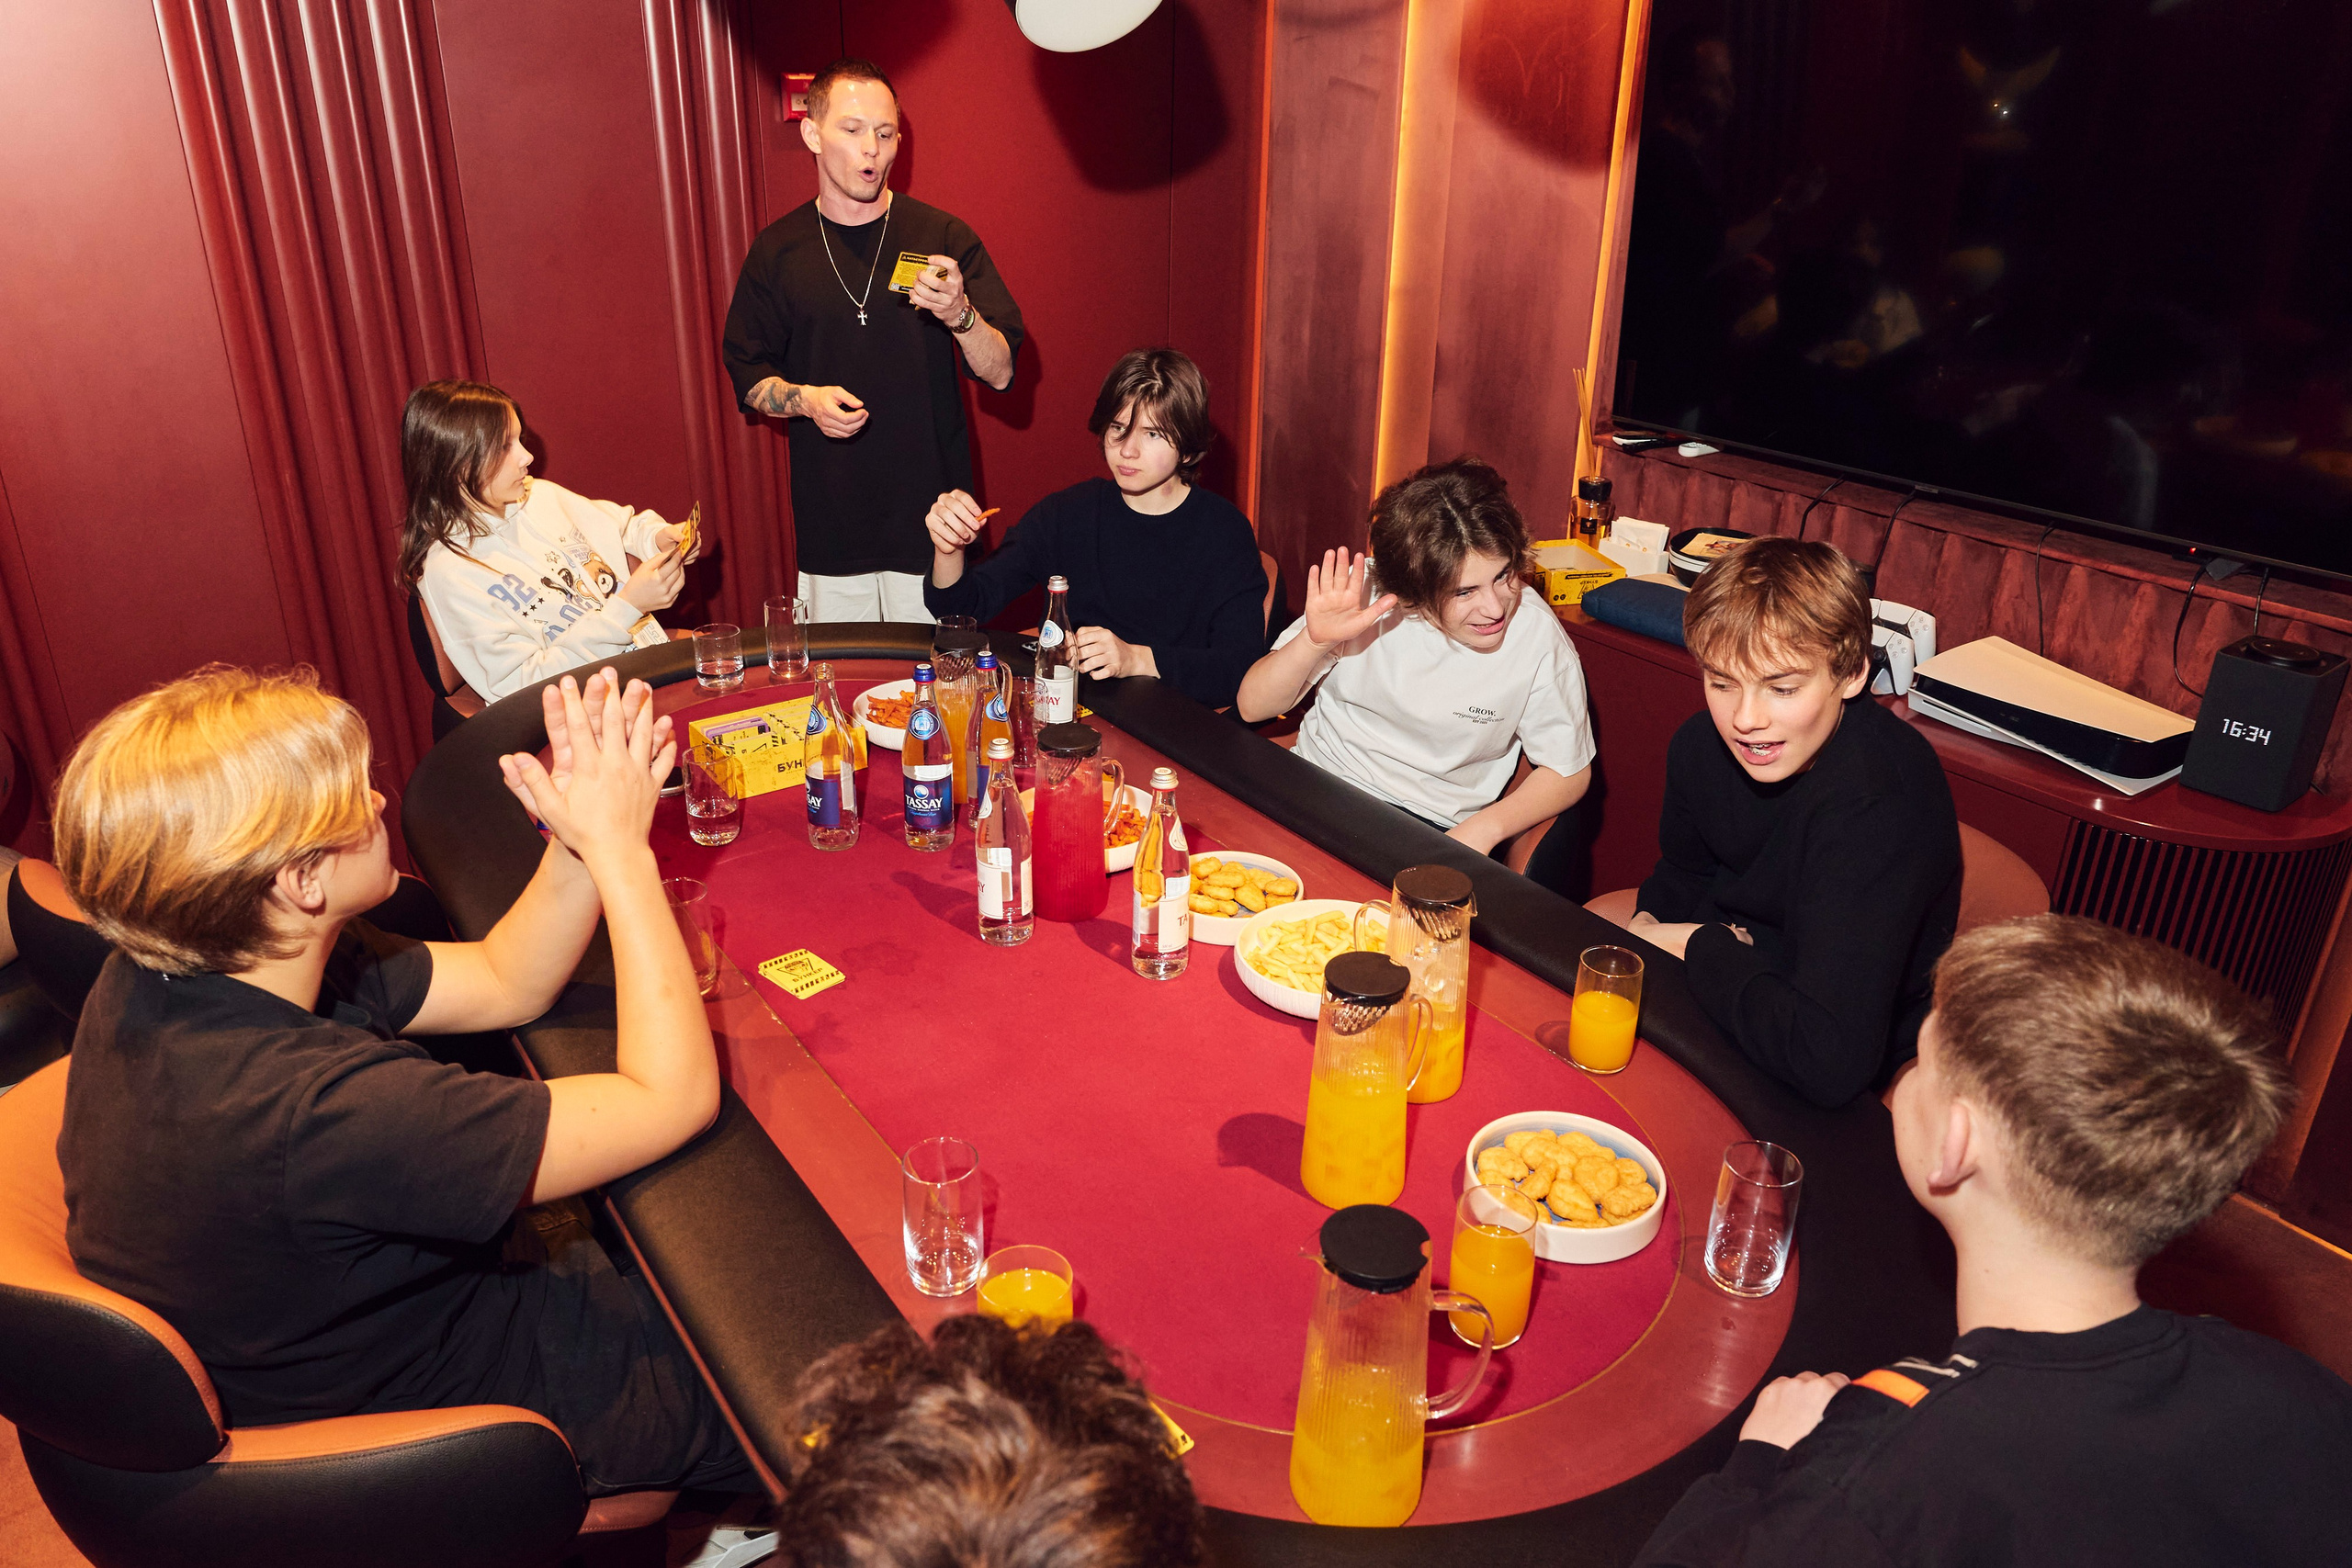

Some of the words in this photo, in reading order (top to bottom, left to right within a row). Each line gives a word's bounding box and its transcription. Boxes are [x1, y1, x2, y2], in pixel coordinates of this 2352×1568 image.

[487, 573, 538, 612] 92
[2222, 718, 2272, 746] 16:34
[777, 759, 804, 773] БУН
[905, 794, 943, 809] TASSAY
